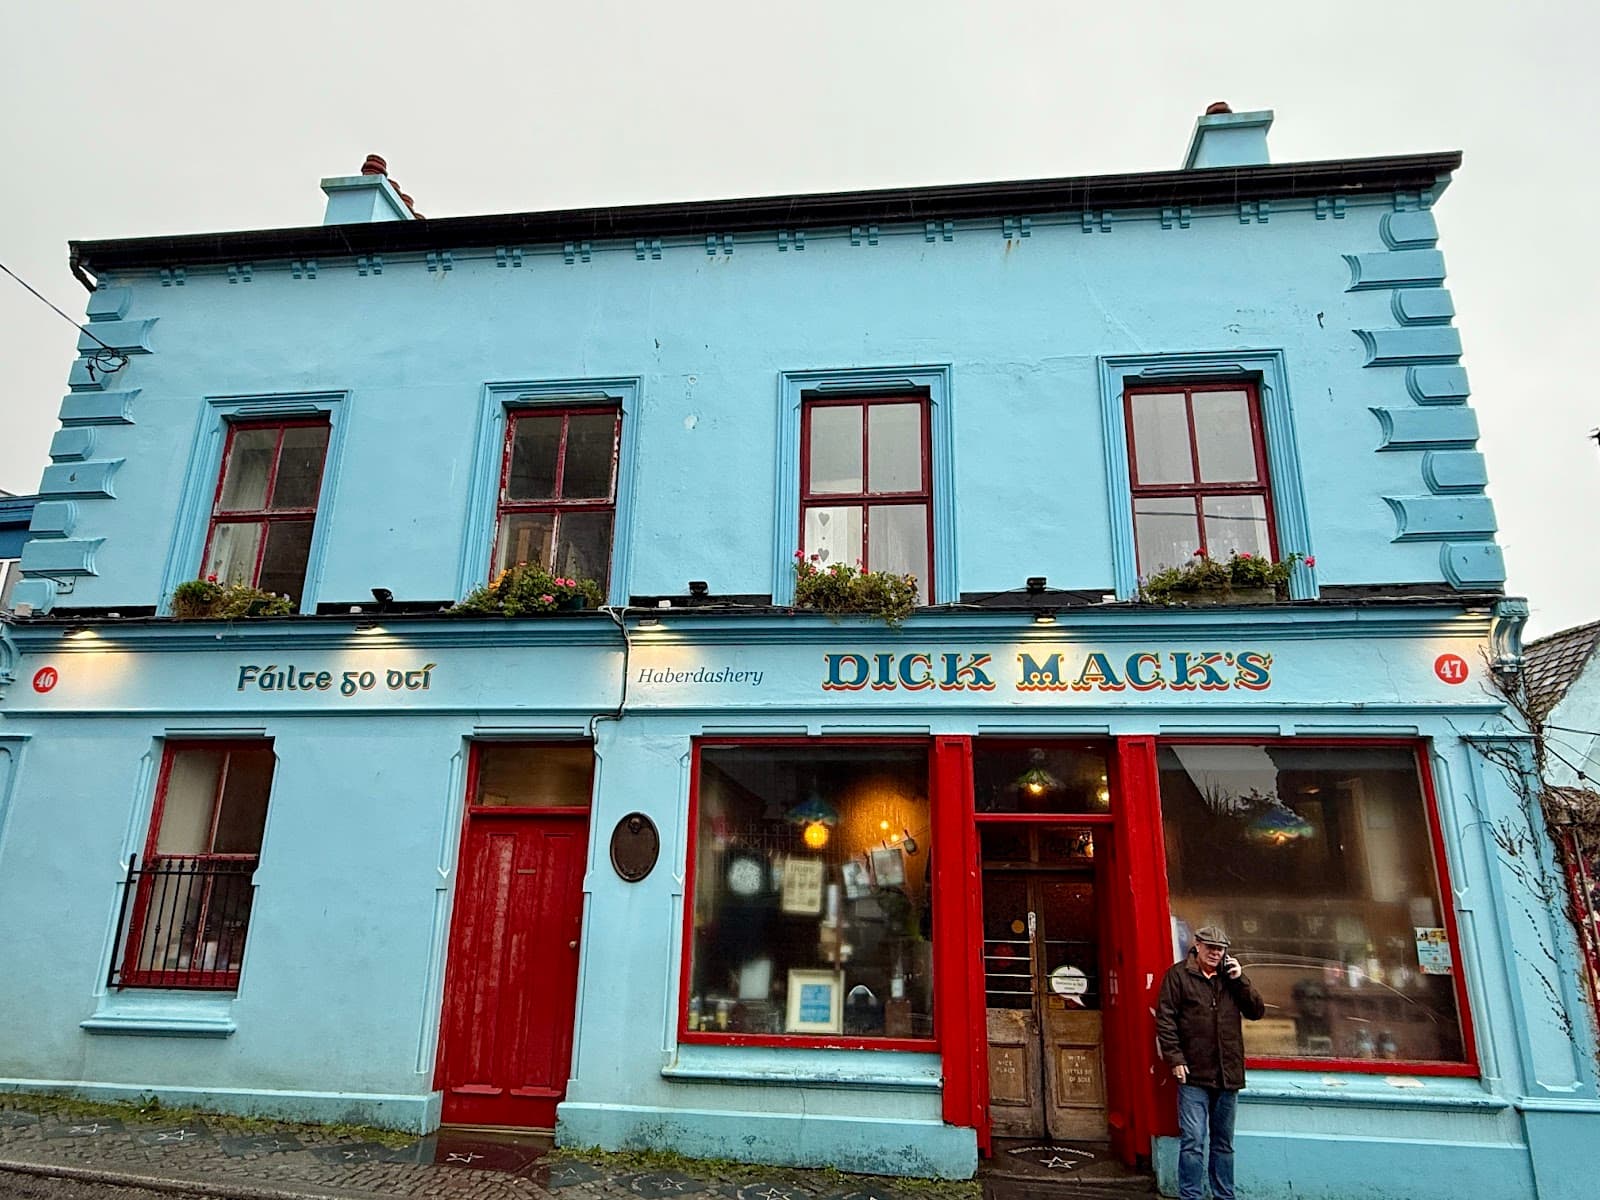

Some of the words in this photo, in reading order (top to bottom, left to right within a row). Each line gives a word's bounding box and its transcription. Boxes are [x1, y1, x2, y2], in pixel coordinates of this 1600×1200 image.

[637, 666, 764, 686] Haberdashery
[822, 653, 996, 691] DICK
[1016, 651, 1273, 692] MACK'S
[1440, 660, 1462, 678] 47
[36, 672, 55, 688] 46
[237, 664, 333, 691] Fáilte
[340, 671, 376, 697] go
